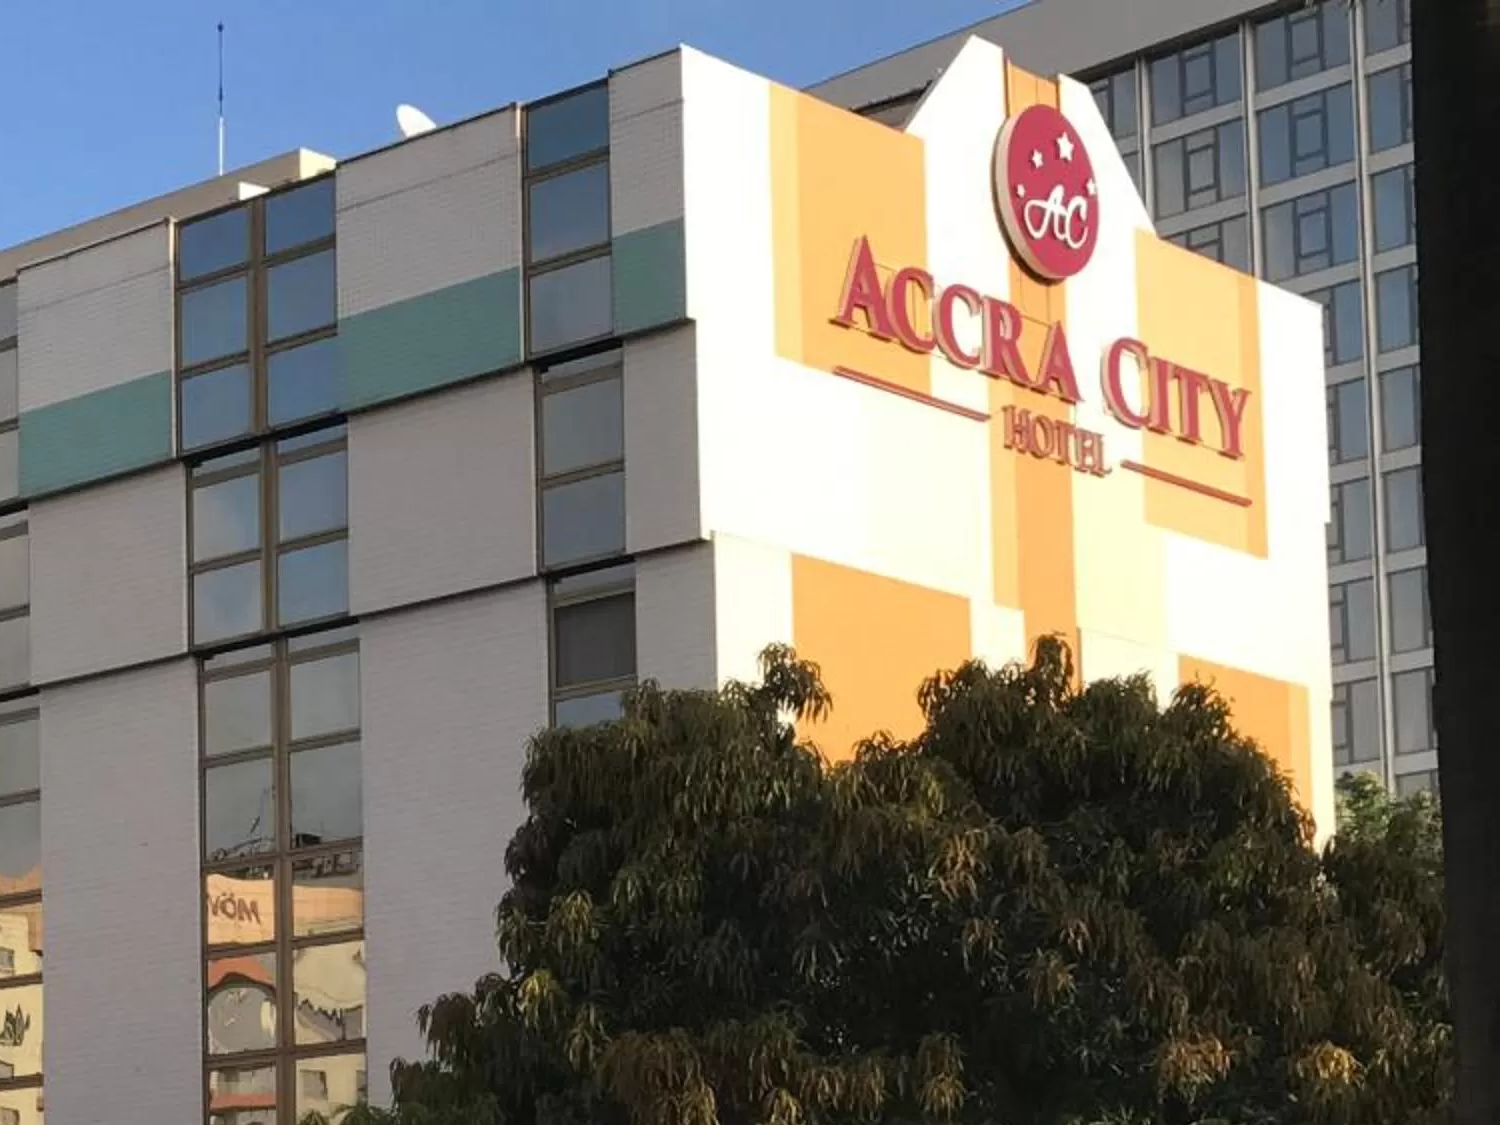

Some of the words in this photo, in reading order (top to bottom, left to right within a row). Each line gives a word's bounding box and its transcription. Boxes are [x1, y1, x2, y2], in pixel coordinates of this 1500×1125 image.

[1024, 183, 1088, 249] AC
[828, 233, 1085, 405] ACCRA
[1100, 336, 1252, 461] CITY
[1002, 404, 1112, 478] HOTEL
